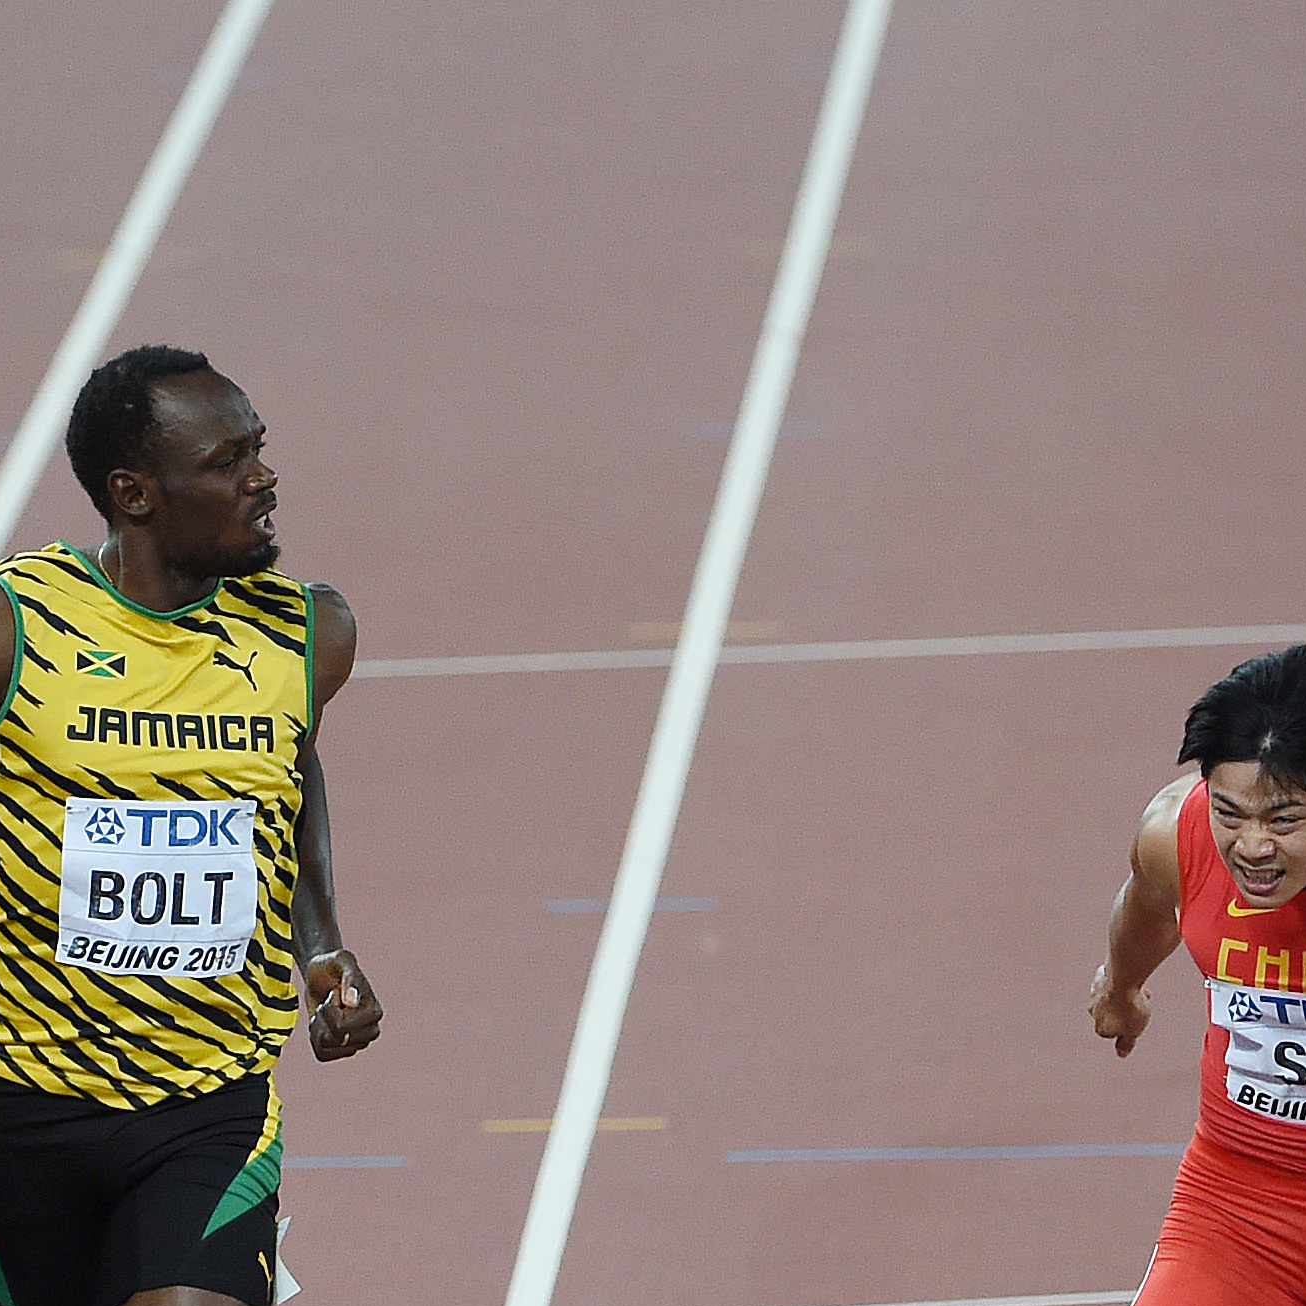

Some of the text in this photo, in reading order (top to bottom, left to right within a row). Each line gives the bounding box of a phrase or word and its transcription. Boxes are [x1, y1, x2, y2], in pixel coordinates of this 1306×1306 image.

[66, 706, 275, 753] JAMAICA
[126, 808, 241, 847] TDK
[87, 870, 233, 926] BOLT
[67, 936, 242, 972] BEIJING 2015
